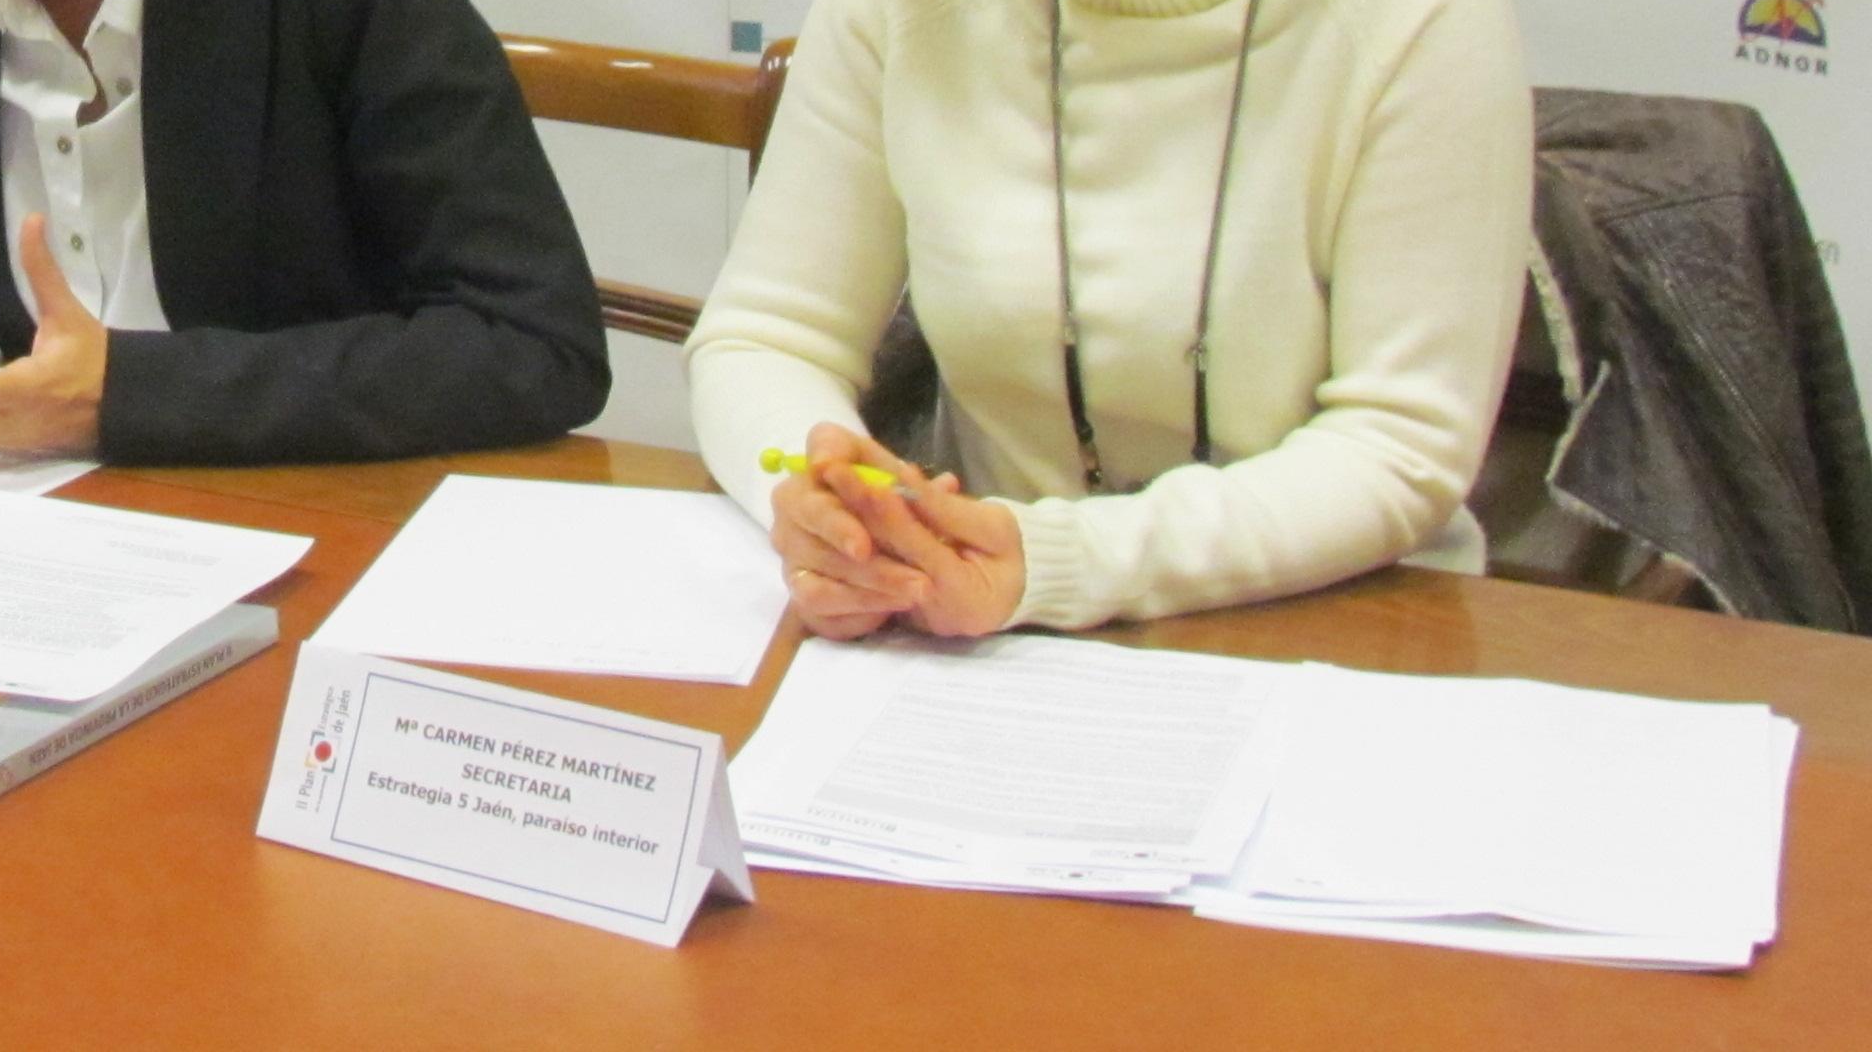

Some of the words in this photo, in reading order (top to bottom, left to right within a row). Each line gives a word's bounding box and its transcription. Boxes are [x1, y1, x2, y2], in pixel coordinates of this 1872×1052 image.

[334, 690, 351, 718] Jaén
[333, 719, 345, 734] de
[423, 724, 497, 755] CARMEN
[501, 739, 557, 768] PÉREZ
[561, 755, 657, 792] MARTÍNEZ
[298, 770, 316, 798] Plan
[461, 763, 572, 803] SECRETARIA
[367, 771, 453, 805] Estrategia
[457, 793, 469, 809] 5
[472, 796, 517, 823] Jaén,
[592, 824, 660, 856] interior
